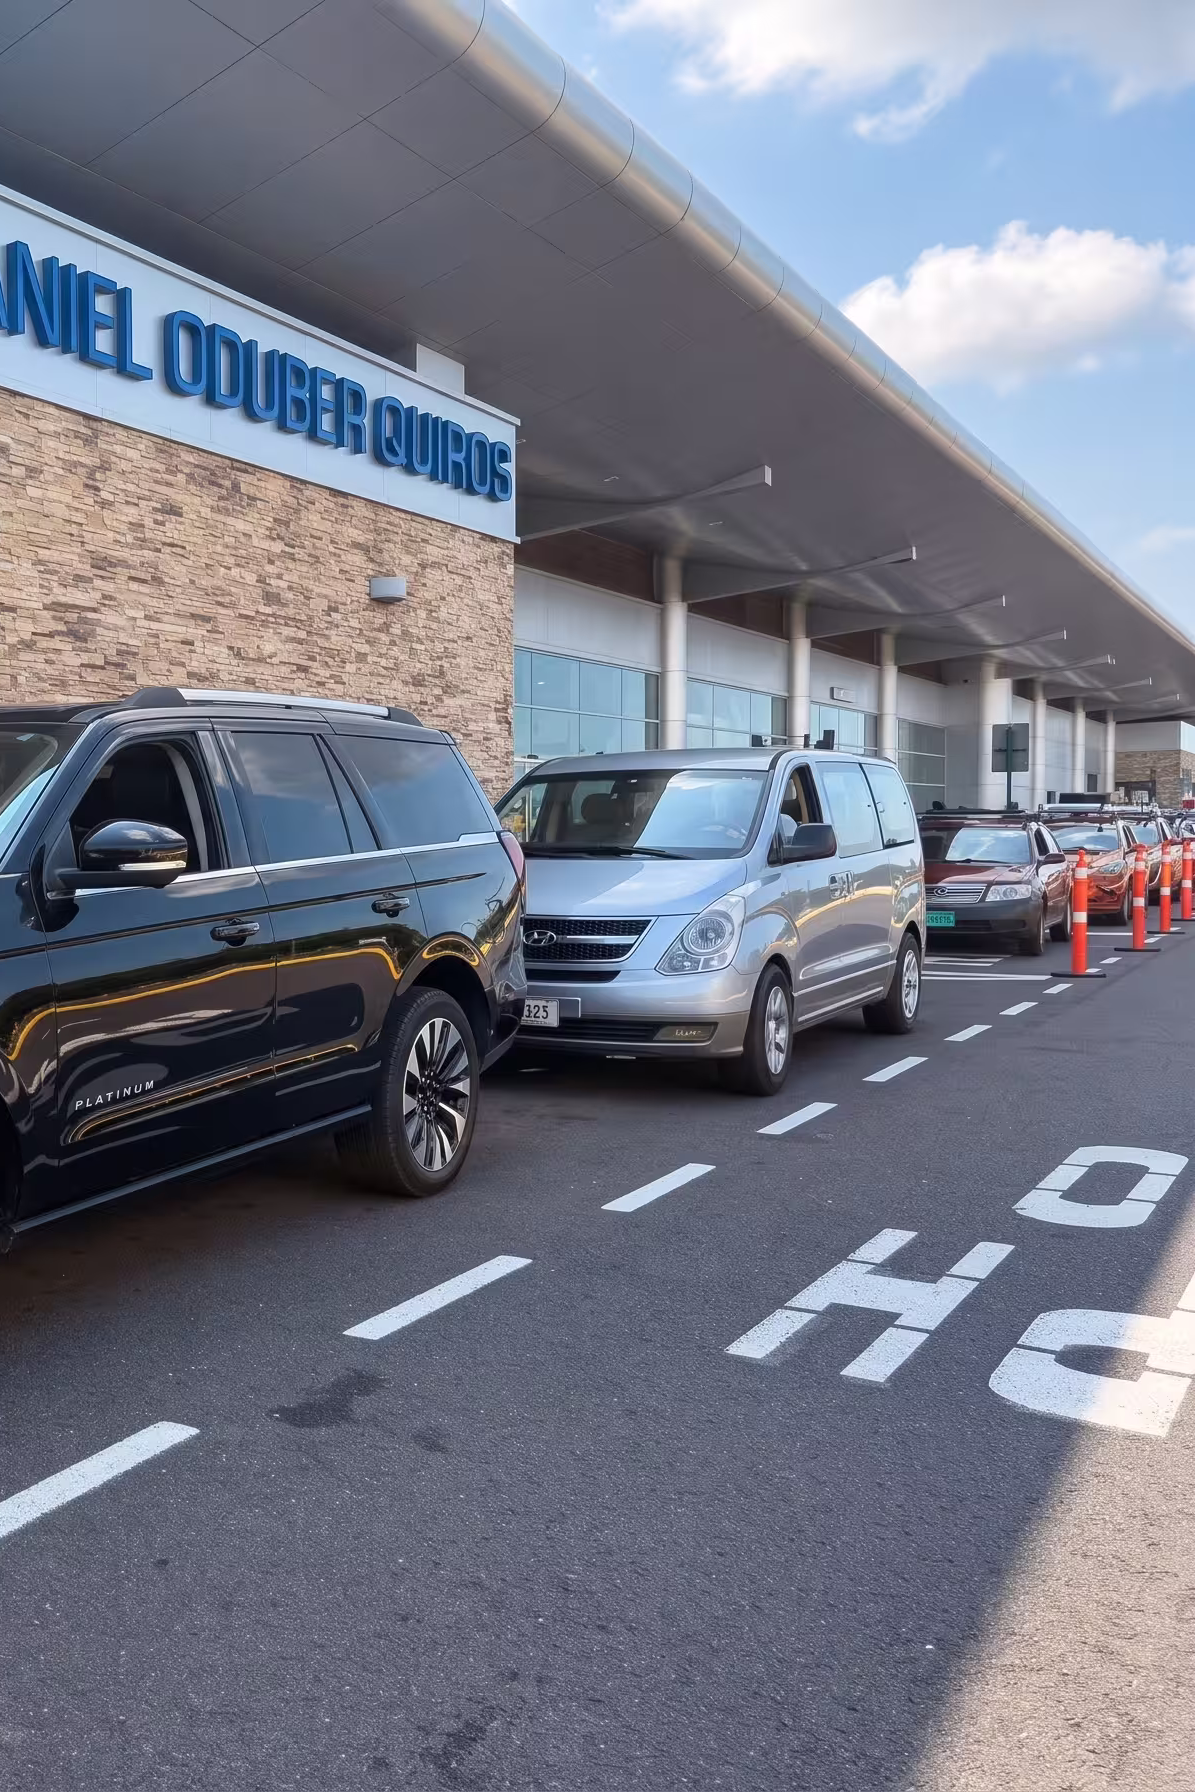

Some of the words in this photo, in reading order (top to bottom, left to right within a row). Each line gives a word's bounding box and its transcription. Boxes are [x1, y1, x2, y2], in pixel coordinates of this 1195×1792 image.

[163, 310, 367, 455] ODUBER
[372, 396, 512, 502] QUIROS
[74, 1080, 155, 1110] PLATINUM
